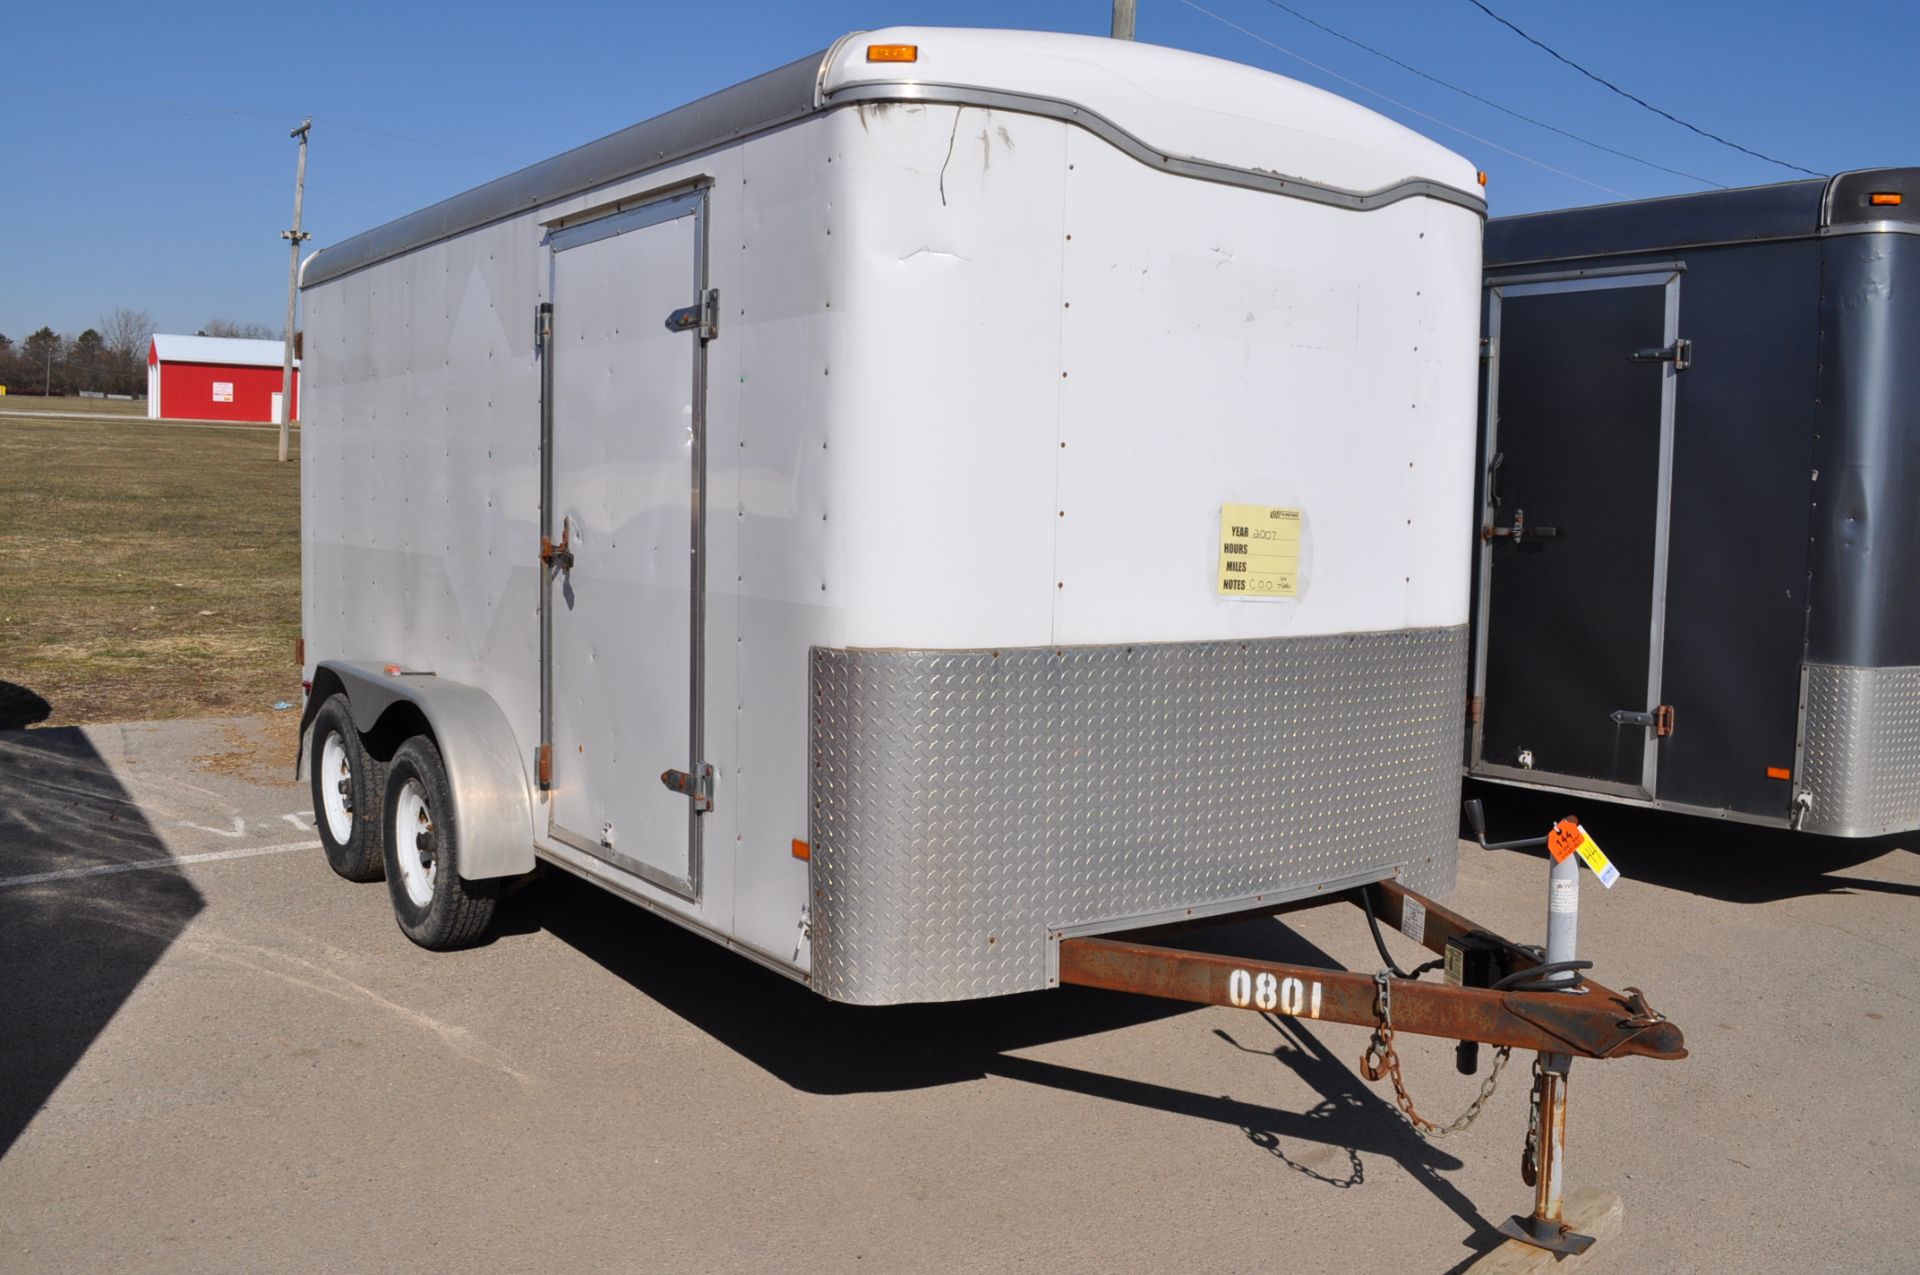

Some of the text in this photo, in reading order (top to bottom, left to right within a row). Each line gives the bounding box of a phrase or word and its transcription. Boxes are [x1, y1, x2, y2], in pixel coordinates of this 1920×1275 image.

[1231, 526, 1277, 540] YEAR 2007
[1224, 543, 1248, 555] HOURS
[1226, 561, 1247, 572] MILES
[1223, 579, 1246, 590] NOTES
[1556, 831, 1572, 847] 144
[1230, 969, 1321, 1018] 0801
